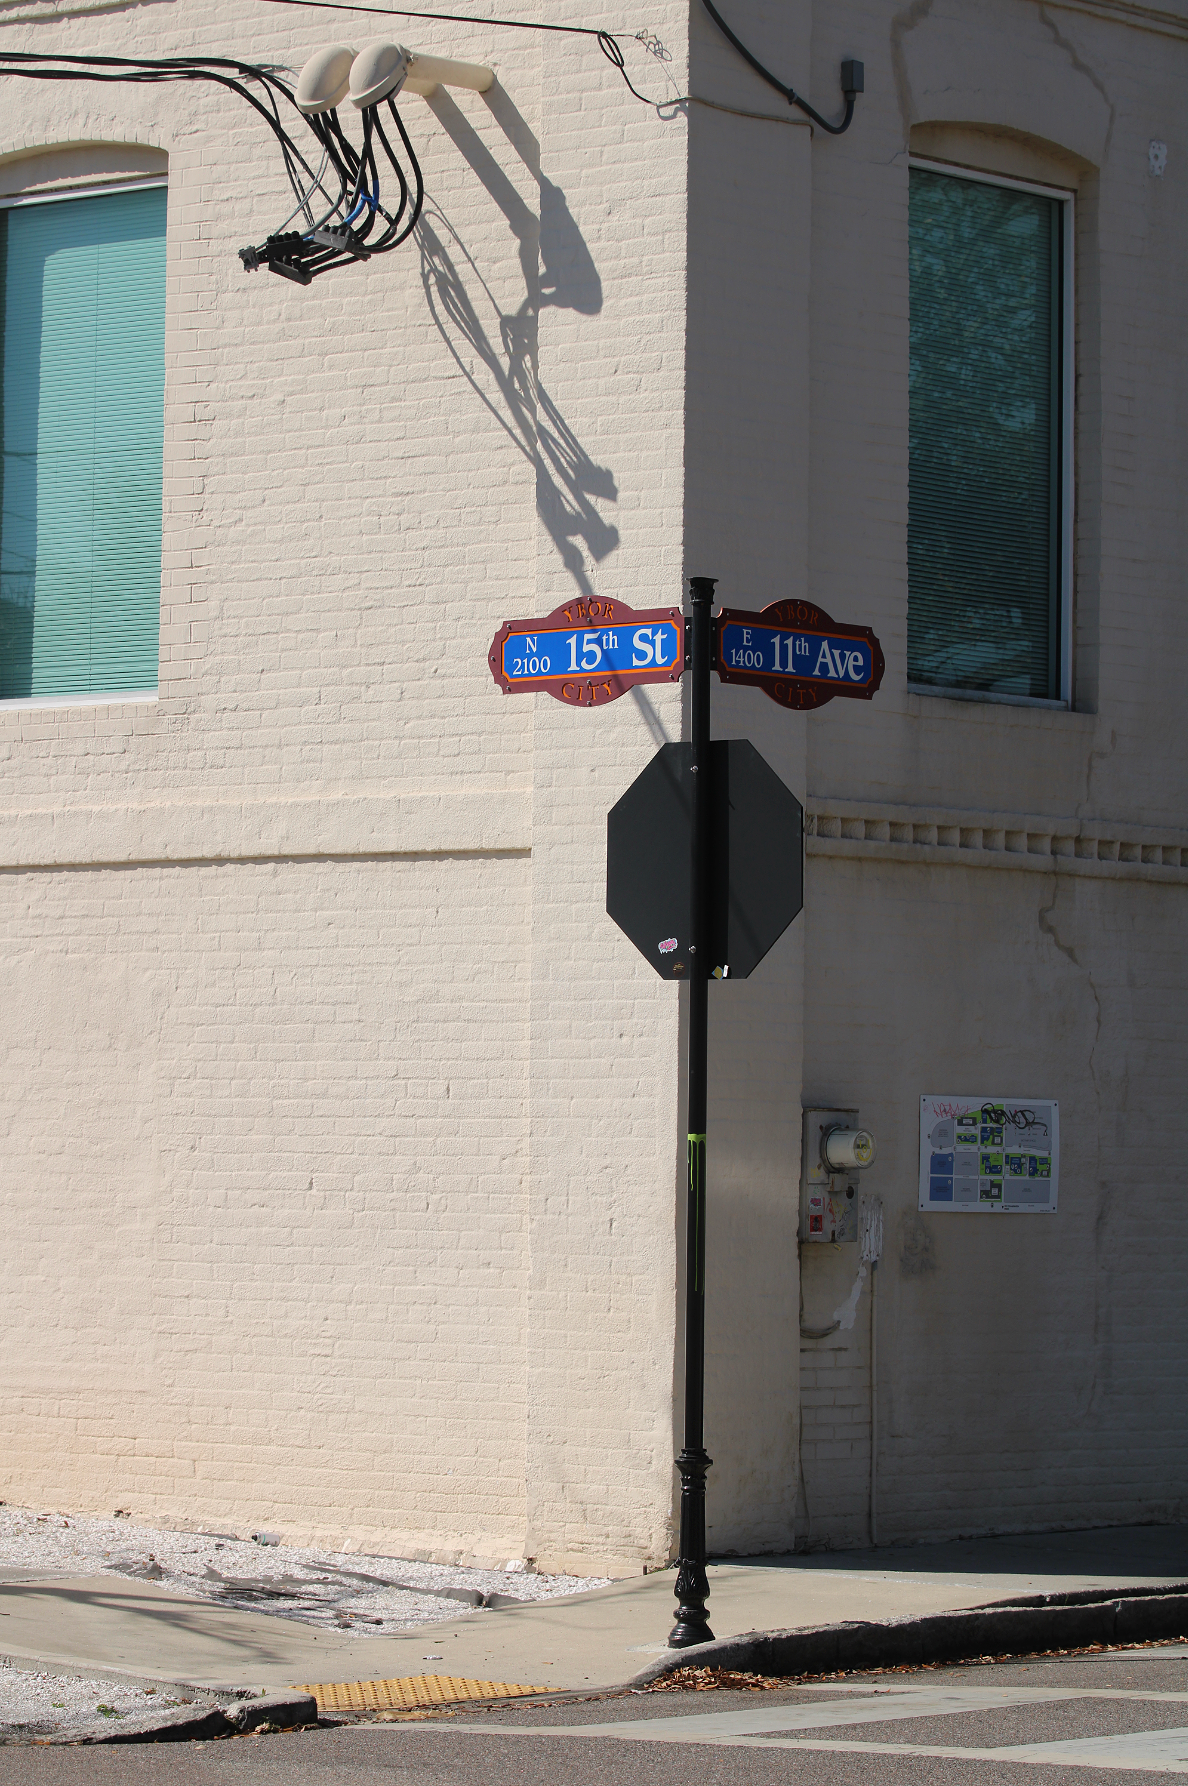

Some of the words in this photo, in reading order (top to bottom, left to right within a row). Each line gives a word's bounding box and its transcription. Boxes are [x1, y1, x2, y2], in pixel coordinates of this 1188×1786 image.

[562, 600, 614, 622] YBOR
[774, 605, 818, 627] YBOR
[525, 636, 537, 653] N
[742, 629, 752, 646] E
[566, 630, 619, 671] 15th
[632, 627, 668, 667] St
[730, 648, 763, 668] 1400
[770, 634, 809, 673] 11th
[812, 639, 864, 681] Ave
[512, 656, 551, 675] 2100
[562, 679, 613, 701] CITY
[774, 682, 818, 704] CITY
